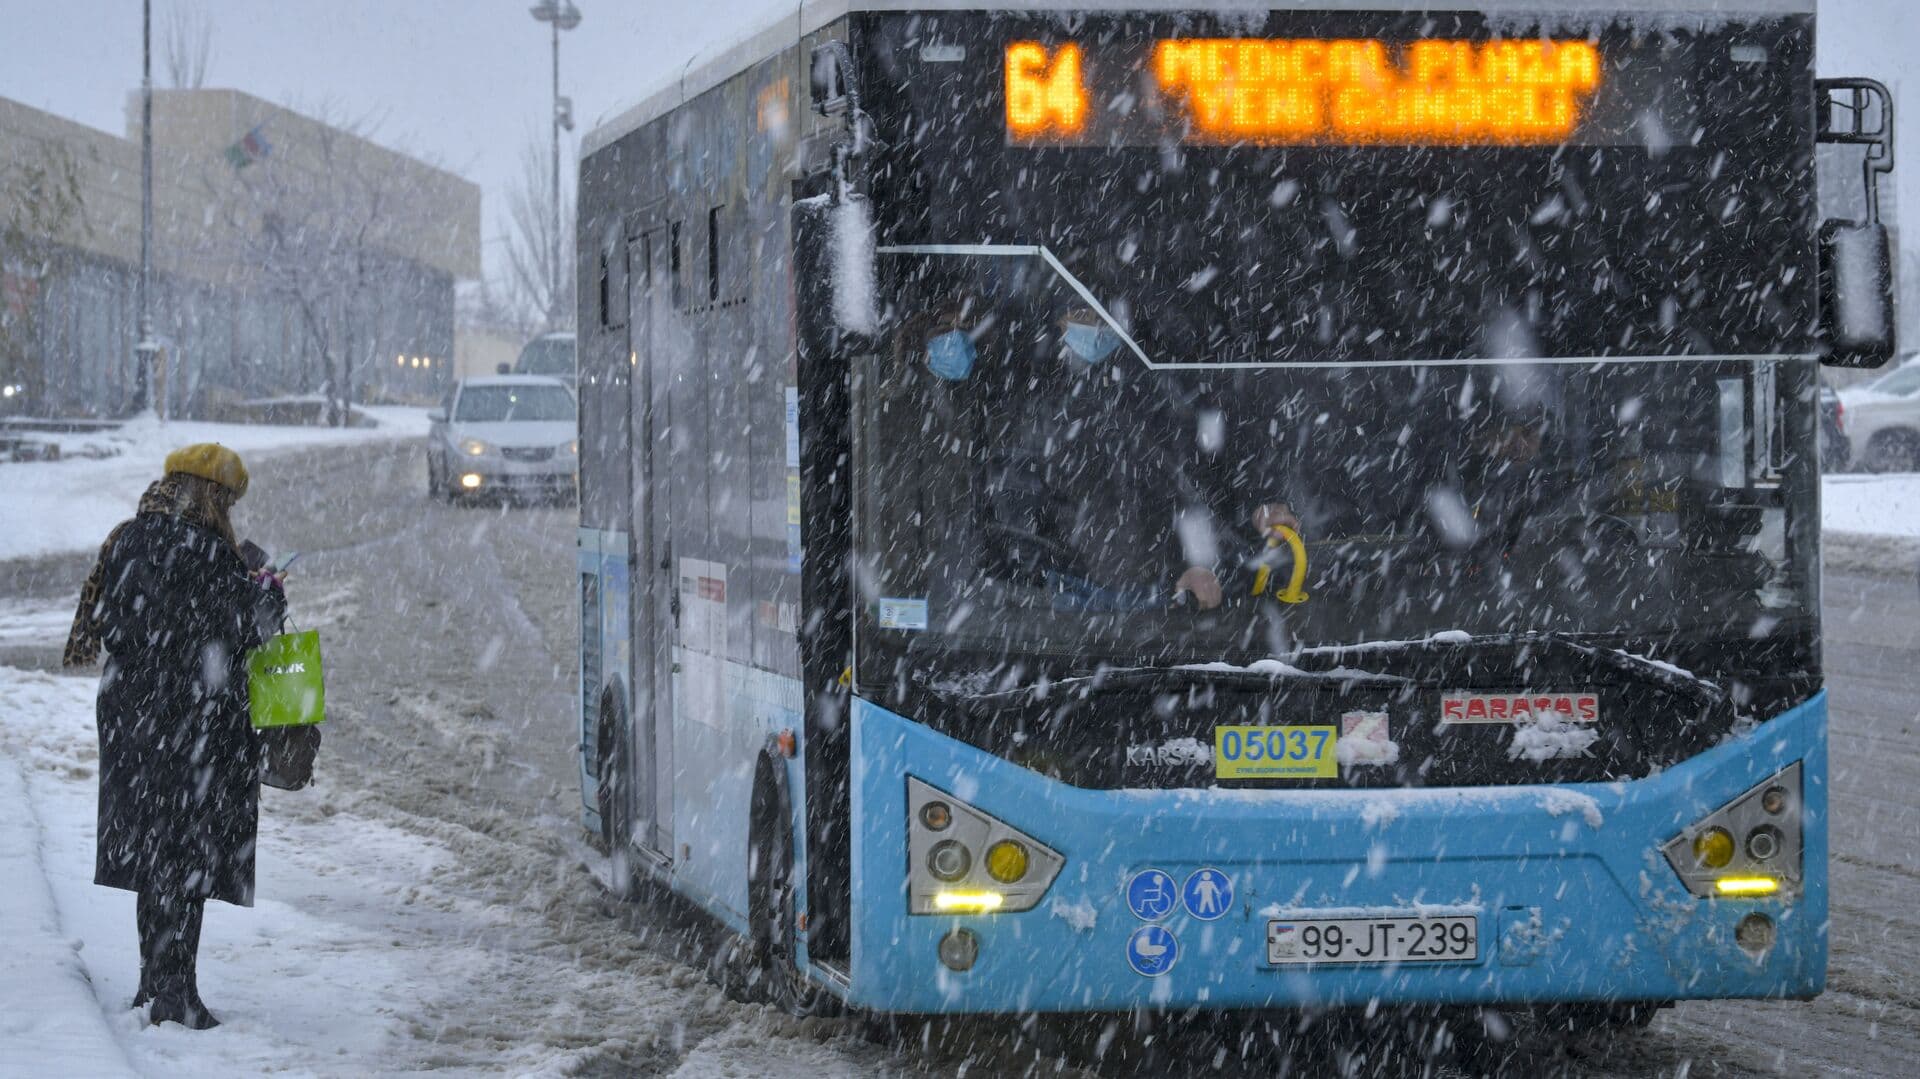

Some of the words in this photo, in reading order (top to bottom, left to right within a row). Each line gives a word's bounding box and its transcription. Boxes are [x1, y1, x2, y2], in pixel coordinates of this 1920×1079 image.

[1415, 42, 1597, 84] PLAZA
[1006, 44, 1083, 127] 64
[1222, 729, 1330, 761] 05037
[1302, 922, 1468, 958] 99-JT-239
